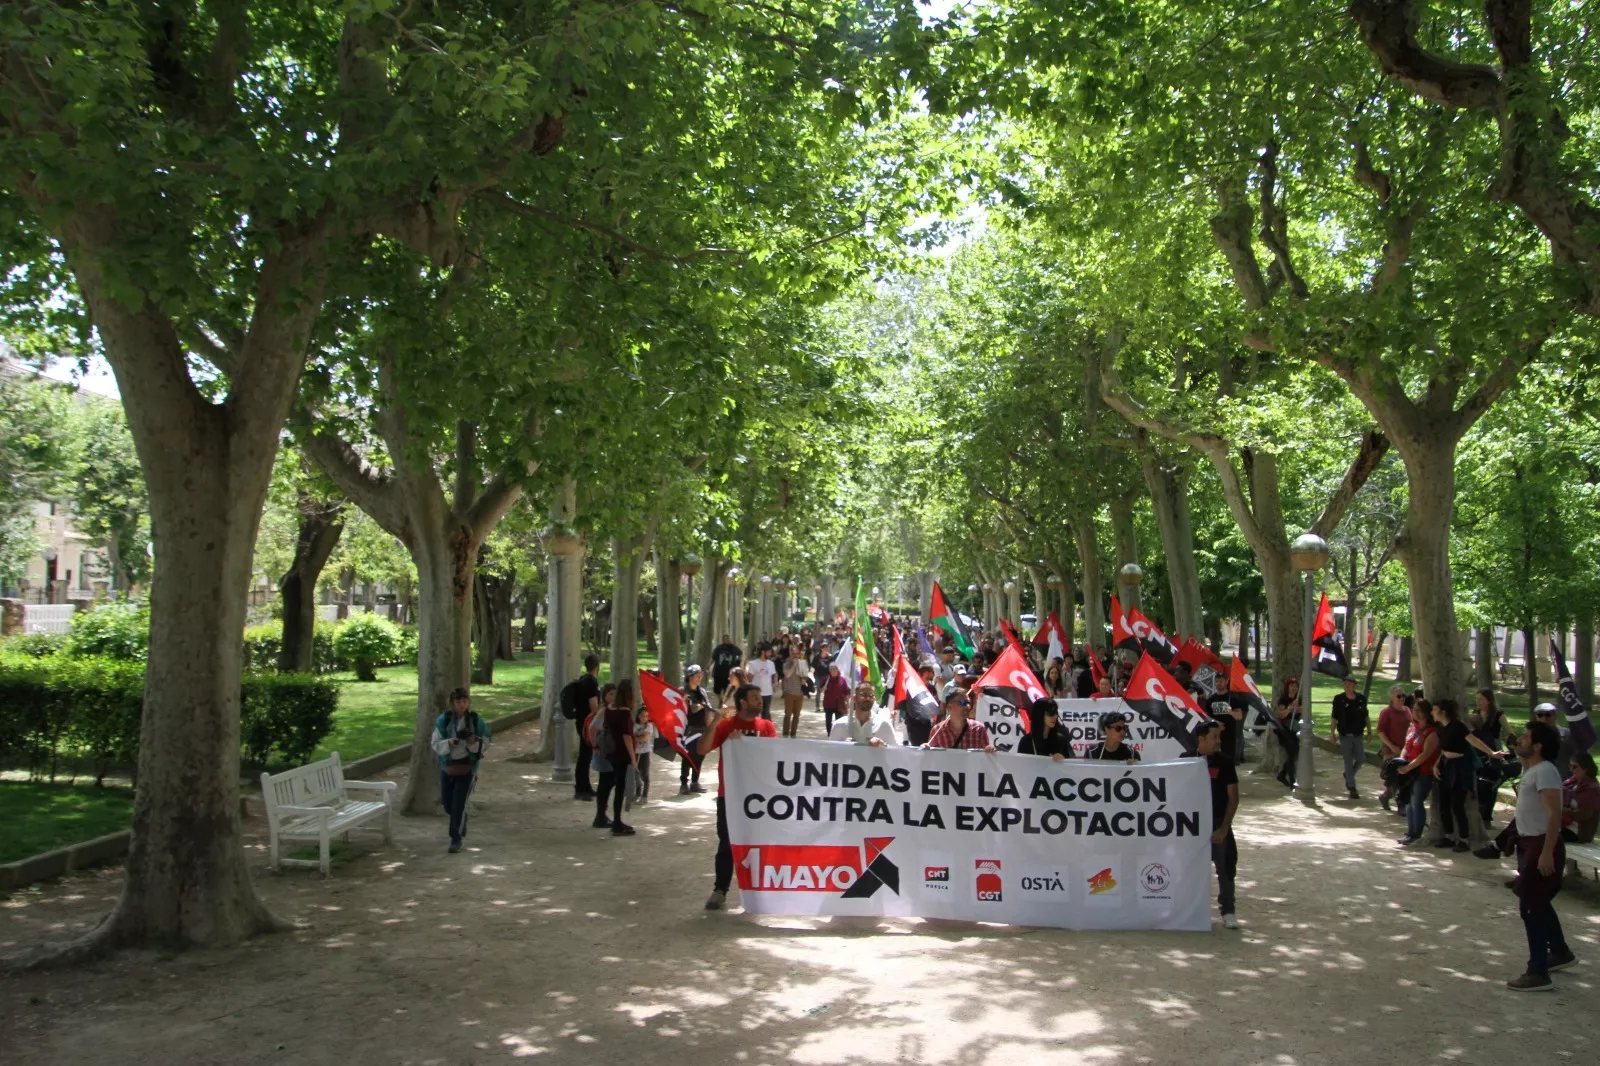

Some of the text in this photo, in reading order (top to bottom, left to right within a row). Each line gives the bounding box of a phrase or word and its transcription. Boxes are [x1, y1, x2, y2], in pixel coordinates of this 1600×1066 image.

[1560, 686, 1583, 709] CGT
[984, 721, 1011, 735] NO
[776, 760, 1167, 803] UNIDAS EN LA ACCIÓN
[743, 793, 1200, 837] CONTRA LA EXPLOTACIÓN
[741, 847, 857, 890] 1 MAYO
[927, 870, 947, 879] CNT
[925, 883, 949, 891] HUESCA
[978, 890, 1001, 901] CGT
